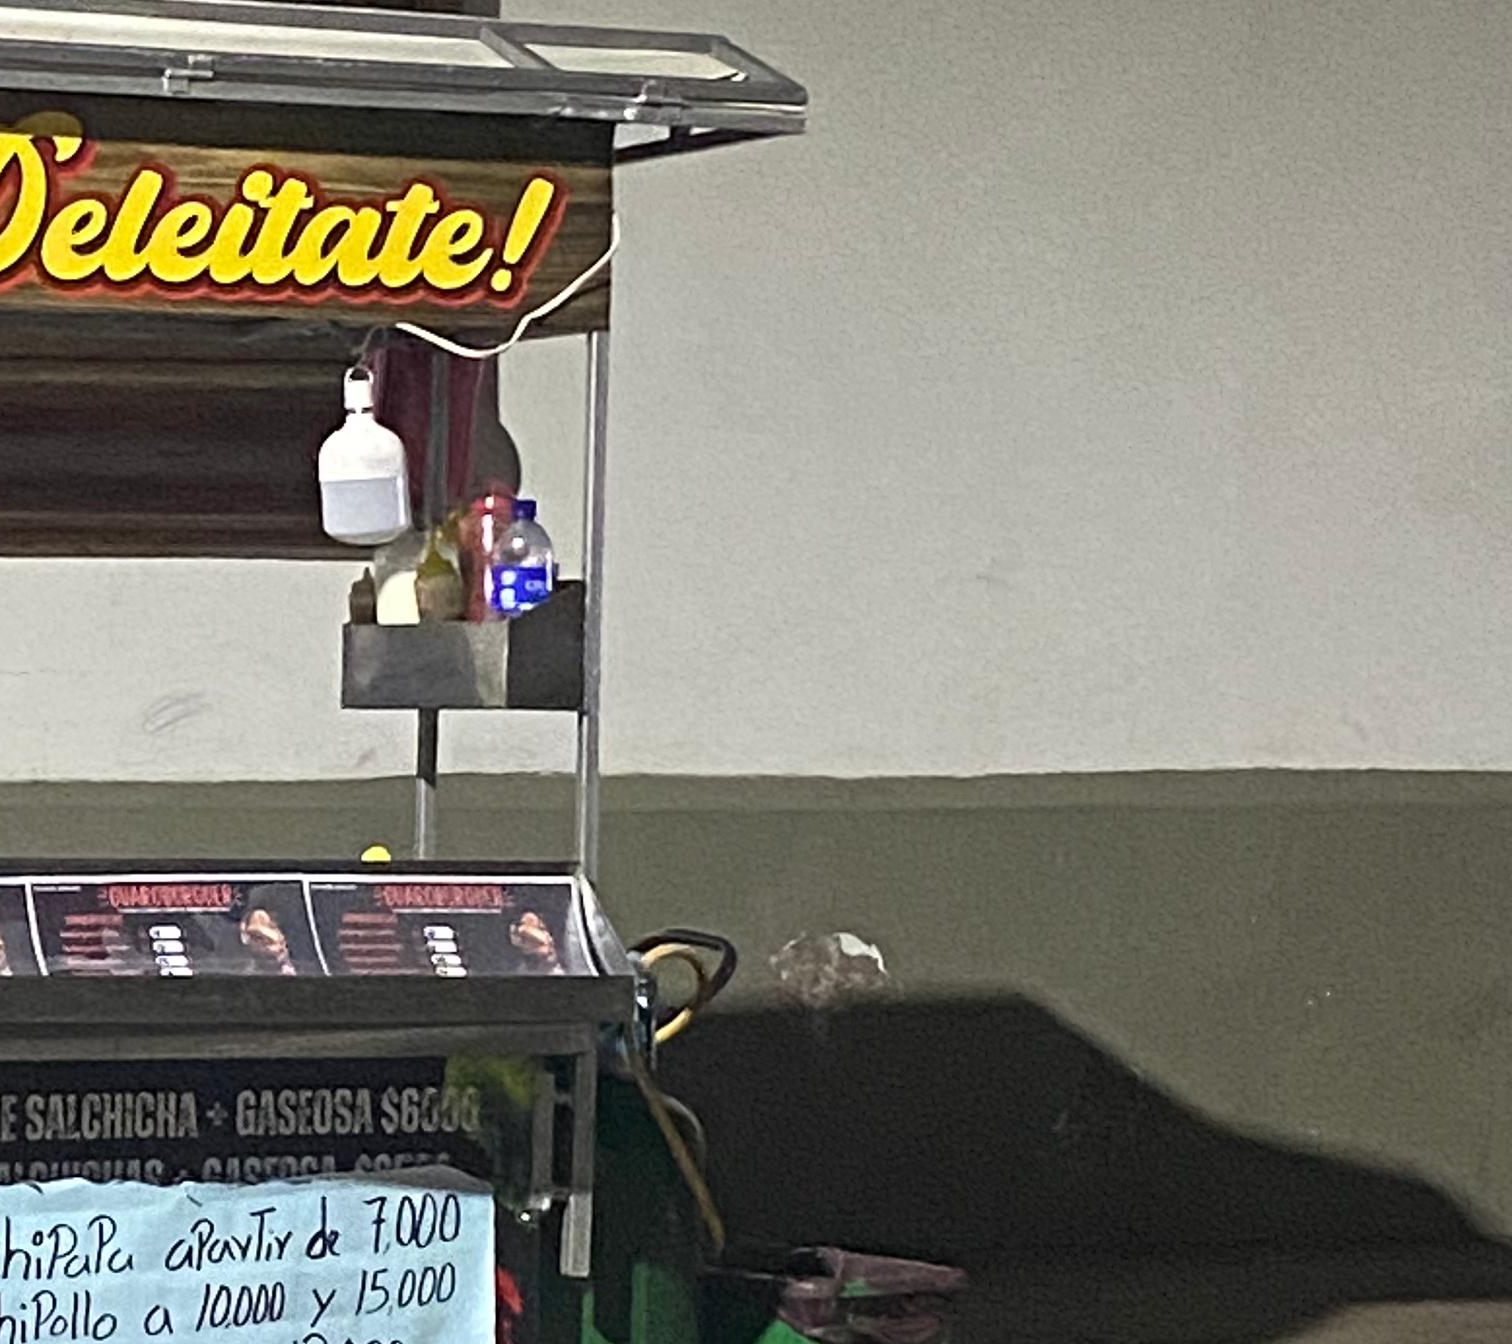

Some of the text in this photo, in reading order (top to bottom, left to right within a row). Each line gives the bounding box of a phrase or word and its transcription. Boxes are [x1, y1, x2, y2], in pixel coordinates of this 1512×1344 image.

[24, 1092, 200, 1142] SALCHICHA
[235, 1089, 374, 1137] GASEOSA
[304, 1194, 342, 1260] de
[143, 1300, 176, 1337] a
[312, 1287, 337, 1330] y
